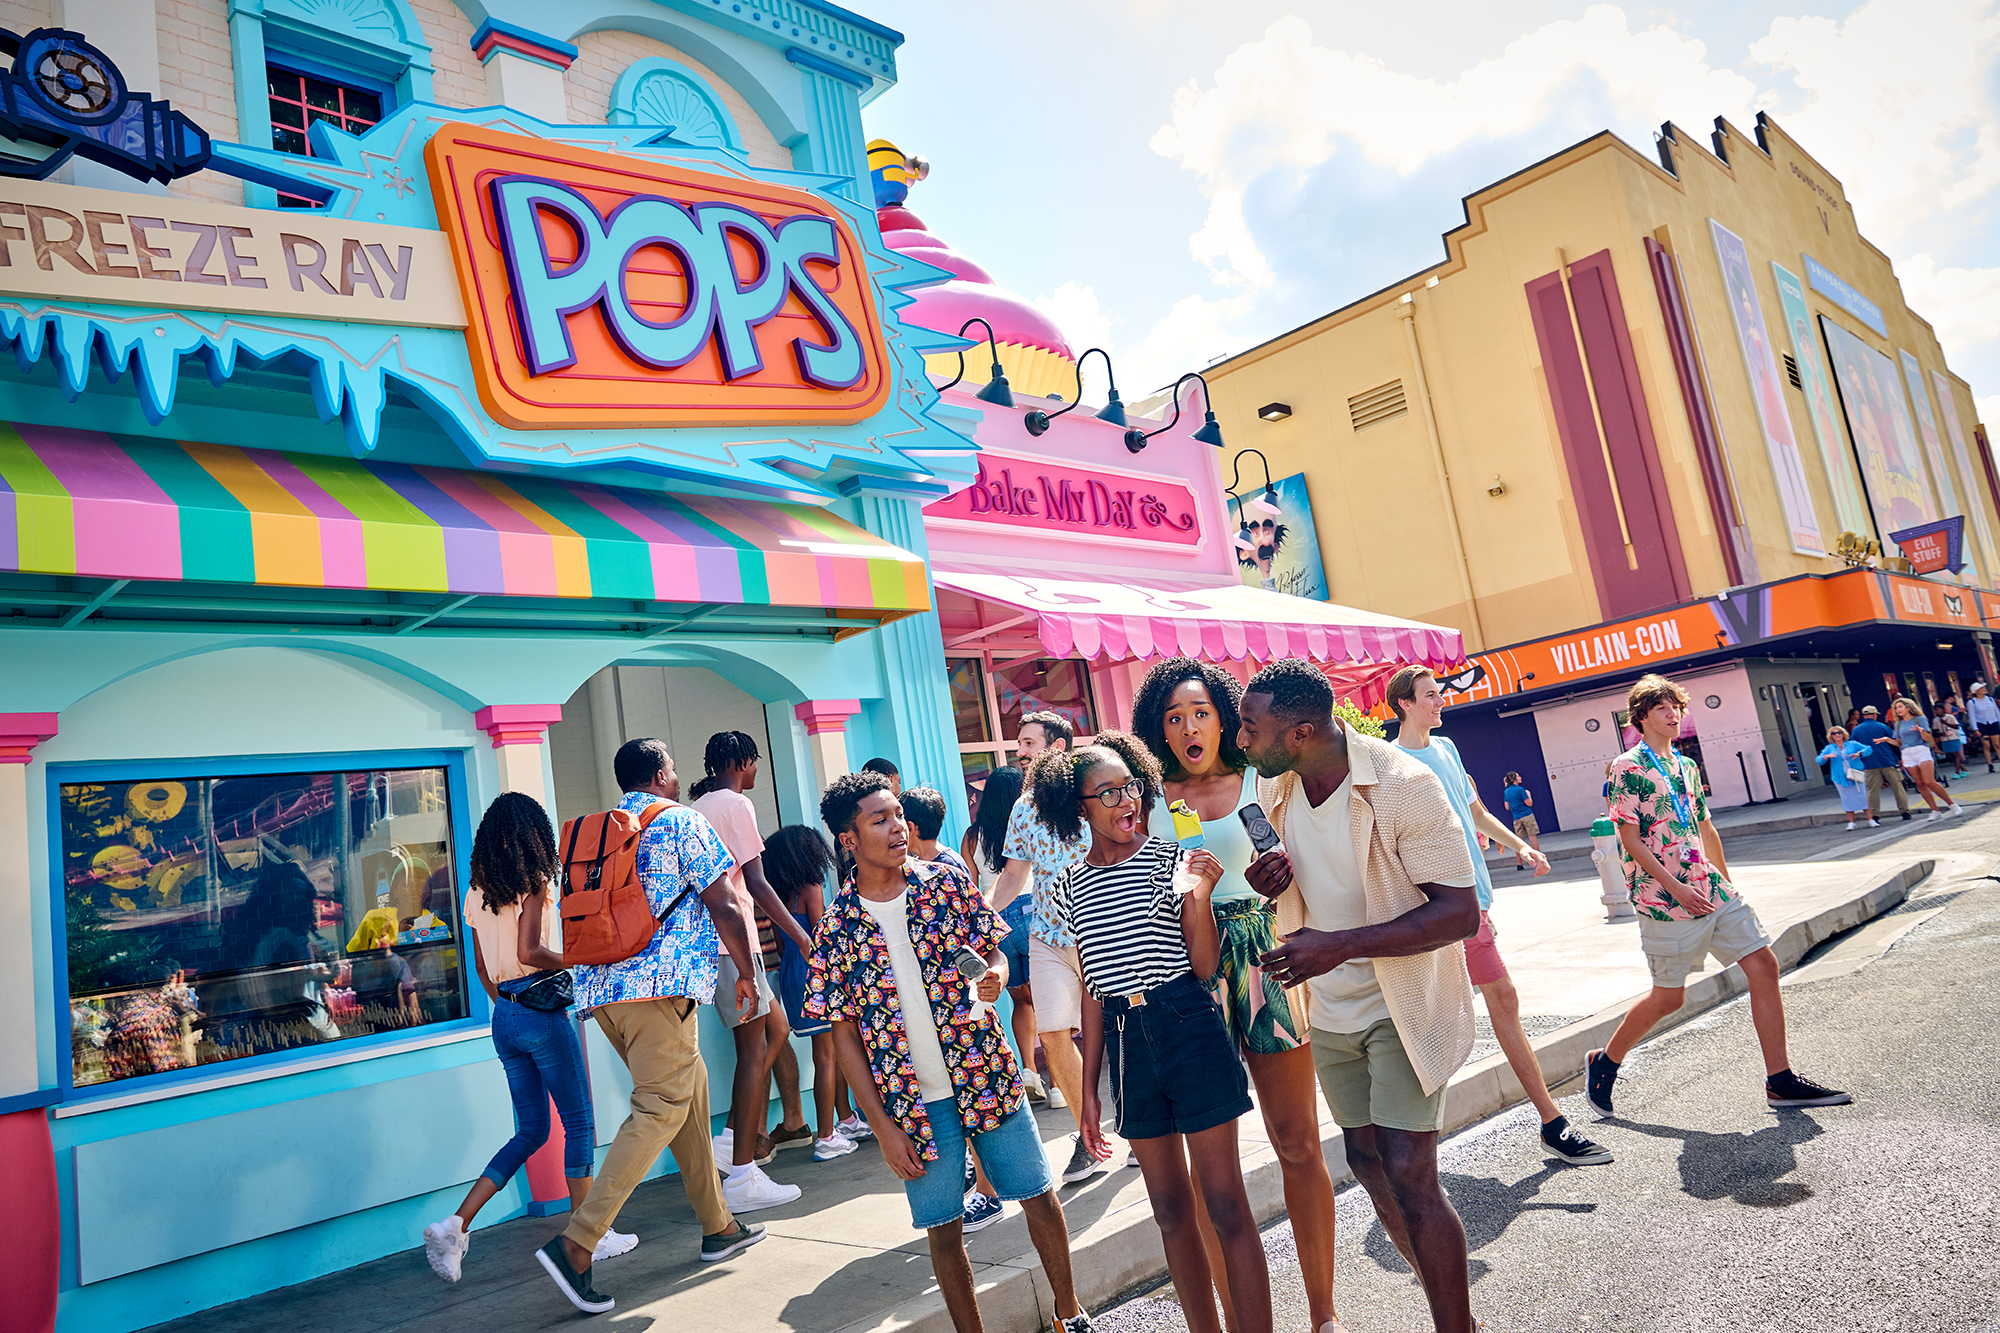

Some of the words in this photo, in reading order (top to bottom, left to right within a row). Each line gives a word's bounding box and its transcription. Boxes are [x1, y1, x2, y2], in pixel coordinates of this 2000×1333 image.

[0, 202, 267, 289] FREEZE
[280, 232, 413, 301] RAY
[489, 174, 866, 390] POPS
[970, 461, 1040, 516] Bake
[1912, 546, 1942, 564] STUFF
[1913, 536, 1936, 551] EVIL
[1549, 618, 1683, 675] VILLAIN-CON
